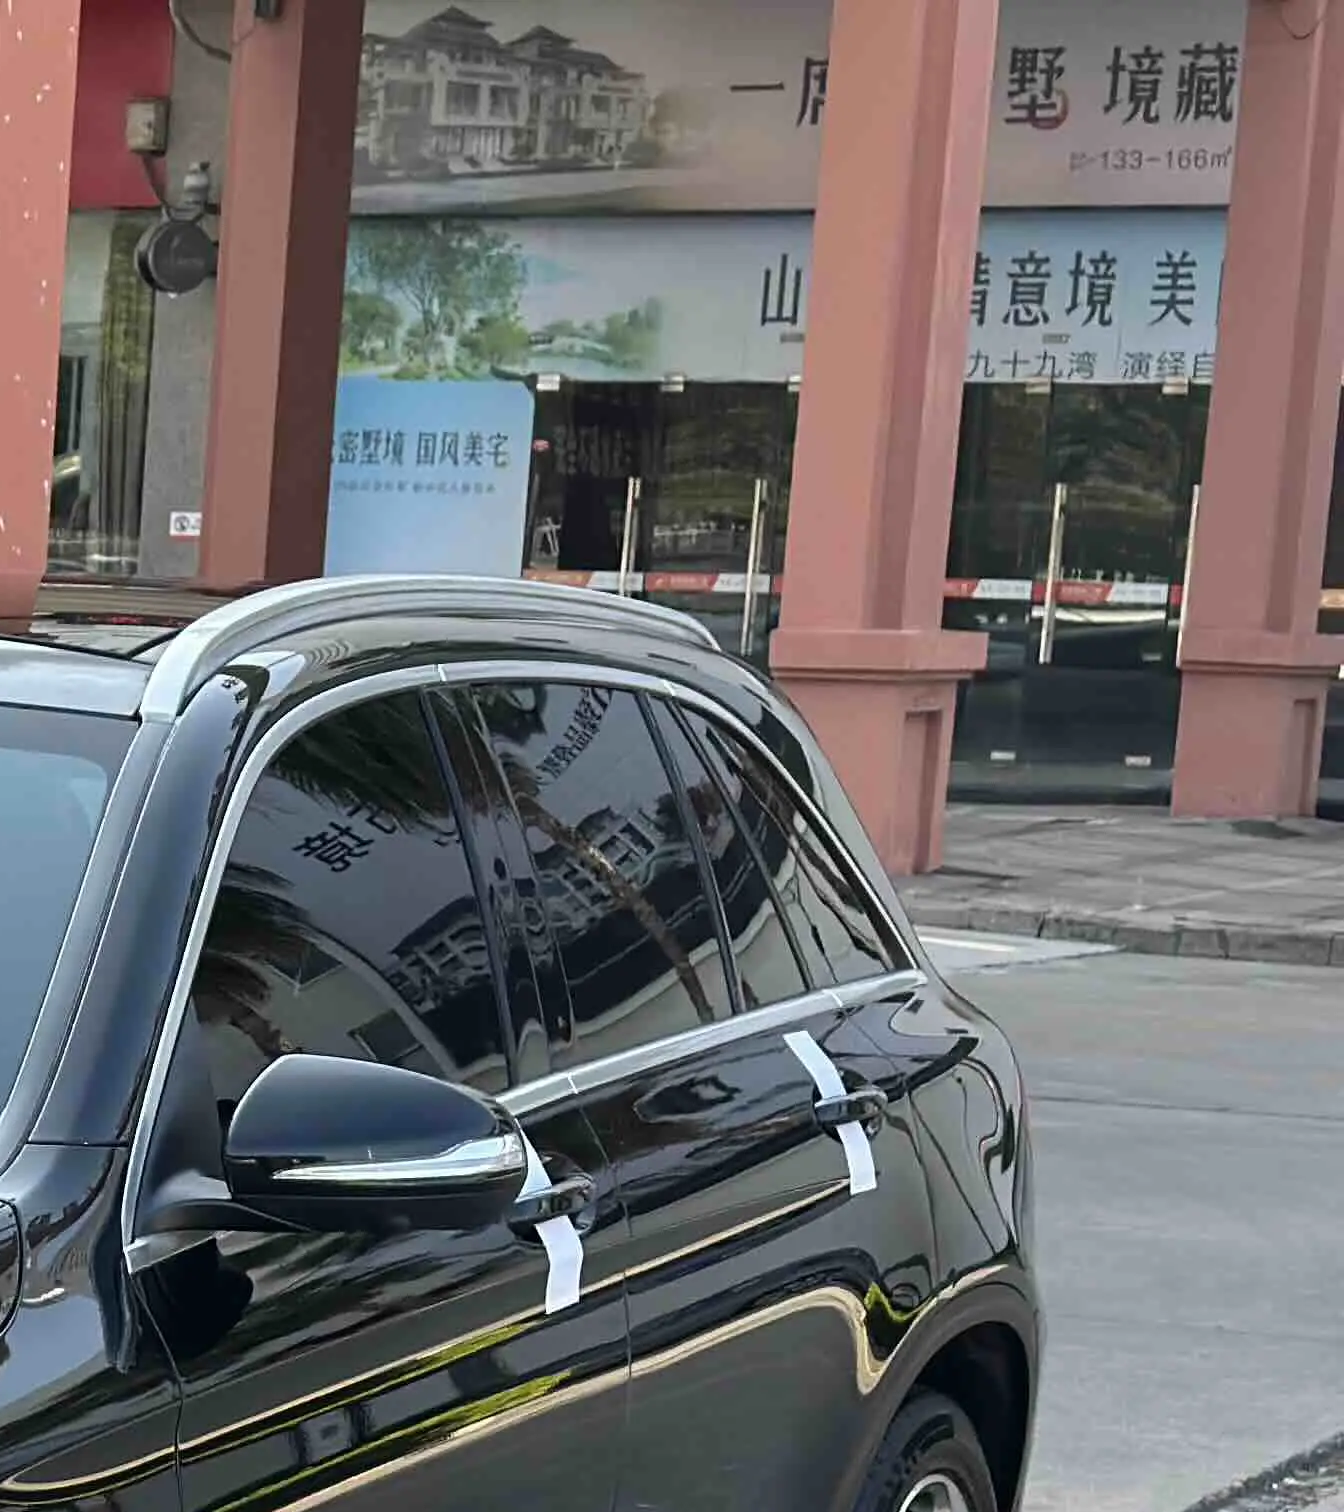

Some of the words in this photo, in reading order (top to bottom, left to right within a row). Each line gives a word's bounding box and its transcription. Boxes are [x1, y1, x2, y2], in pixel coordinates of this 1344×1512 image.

[1004, 45, 1067, 124] 墅
[1103, 42, 1239, 125] 境藏
[760, 253, 802, 326] 山
